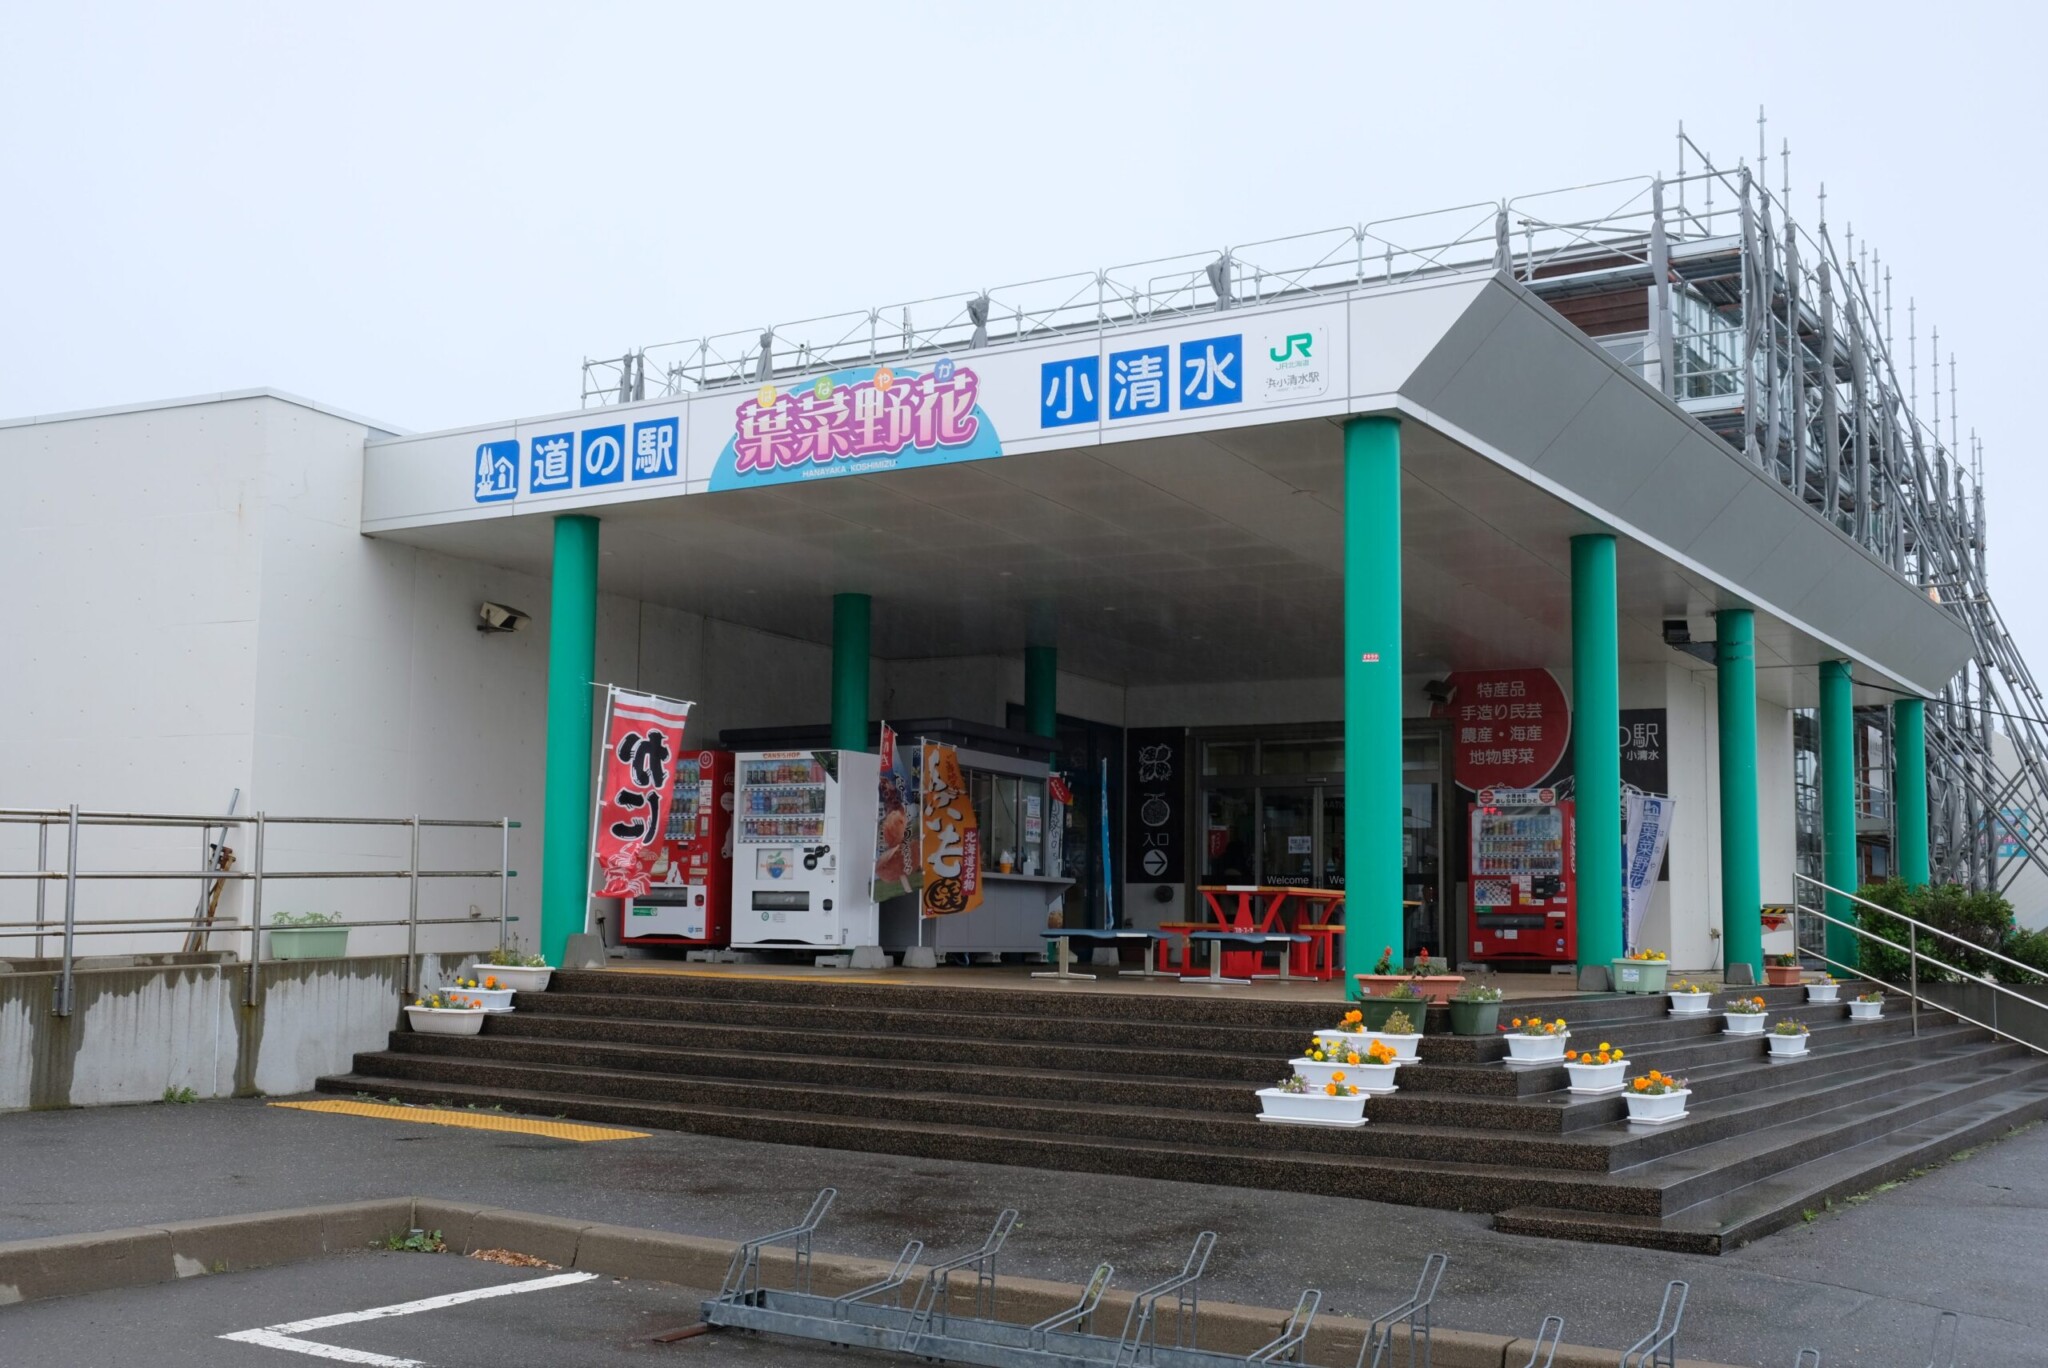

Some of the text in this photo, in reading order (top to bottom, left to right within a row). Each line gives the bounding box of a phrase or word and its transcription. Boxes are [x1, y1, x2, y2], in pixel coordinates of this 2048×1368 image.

[1270, 333, 1312, 362] JR
[1045, 344, 1236, 420] 小清水
[1265, 371, 1320, 388] 浜小清水駅
[736, 368, 980, 474] 葉菜野花
[533, 425, 675, 488] 道の駅
[802, 459, 896, 478] HANAYAKA KOSHIMIZU
[1476, 680, 1526, 698] 特産品
[1460, 703, 1543, 721] 手造り民芸
[1460, 725, 1543, 744] 農産・海産
[1469, 748, 1535, 766] 地物野菜
[1626, 749, 1660, 761] 小清水
[1142, 832, 1169, 848] 入口
[963, 832, 977, 891] 北海道名物
[1629, 822, 1659, 890] 葉菜野花
[1266, 874, 1309, 885] Welcome
